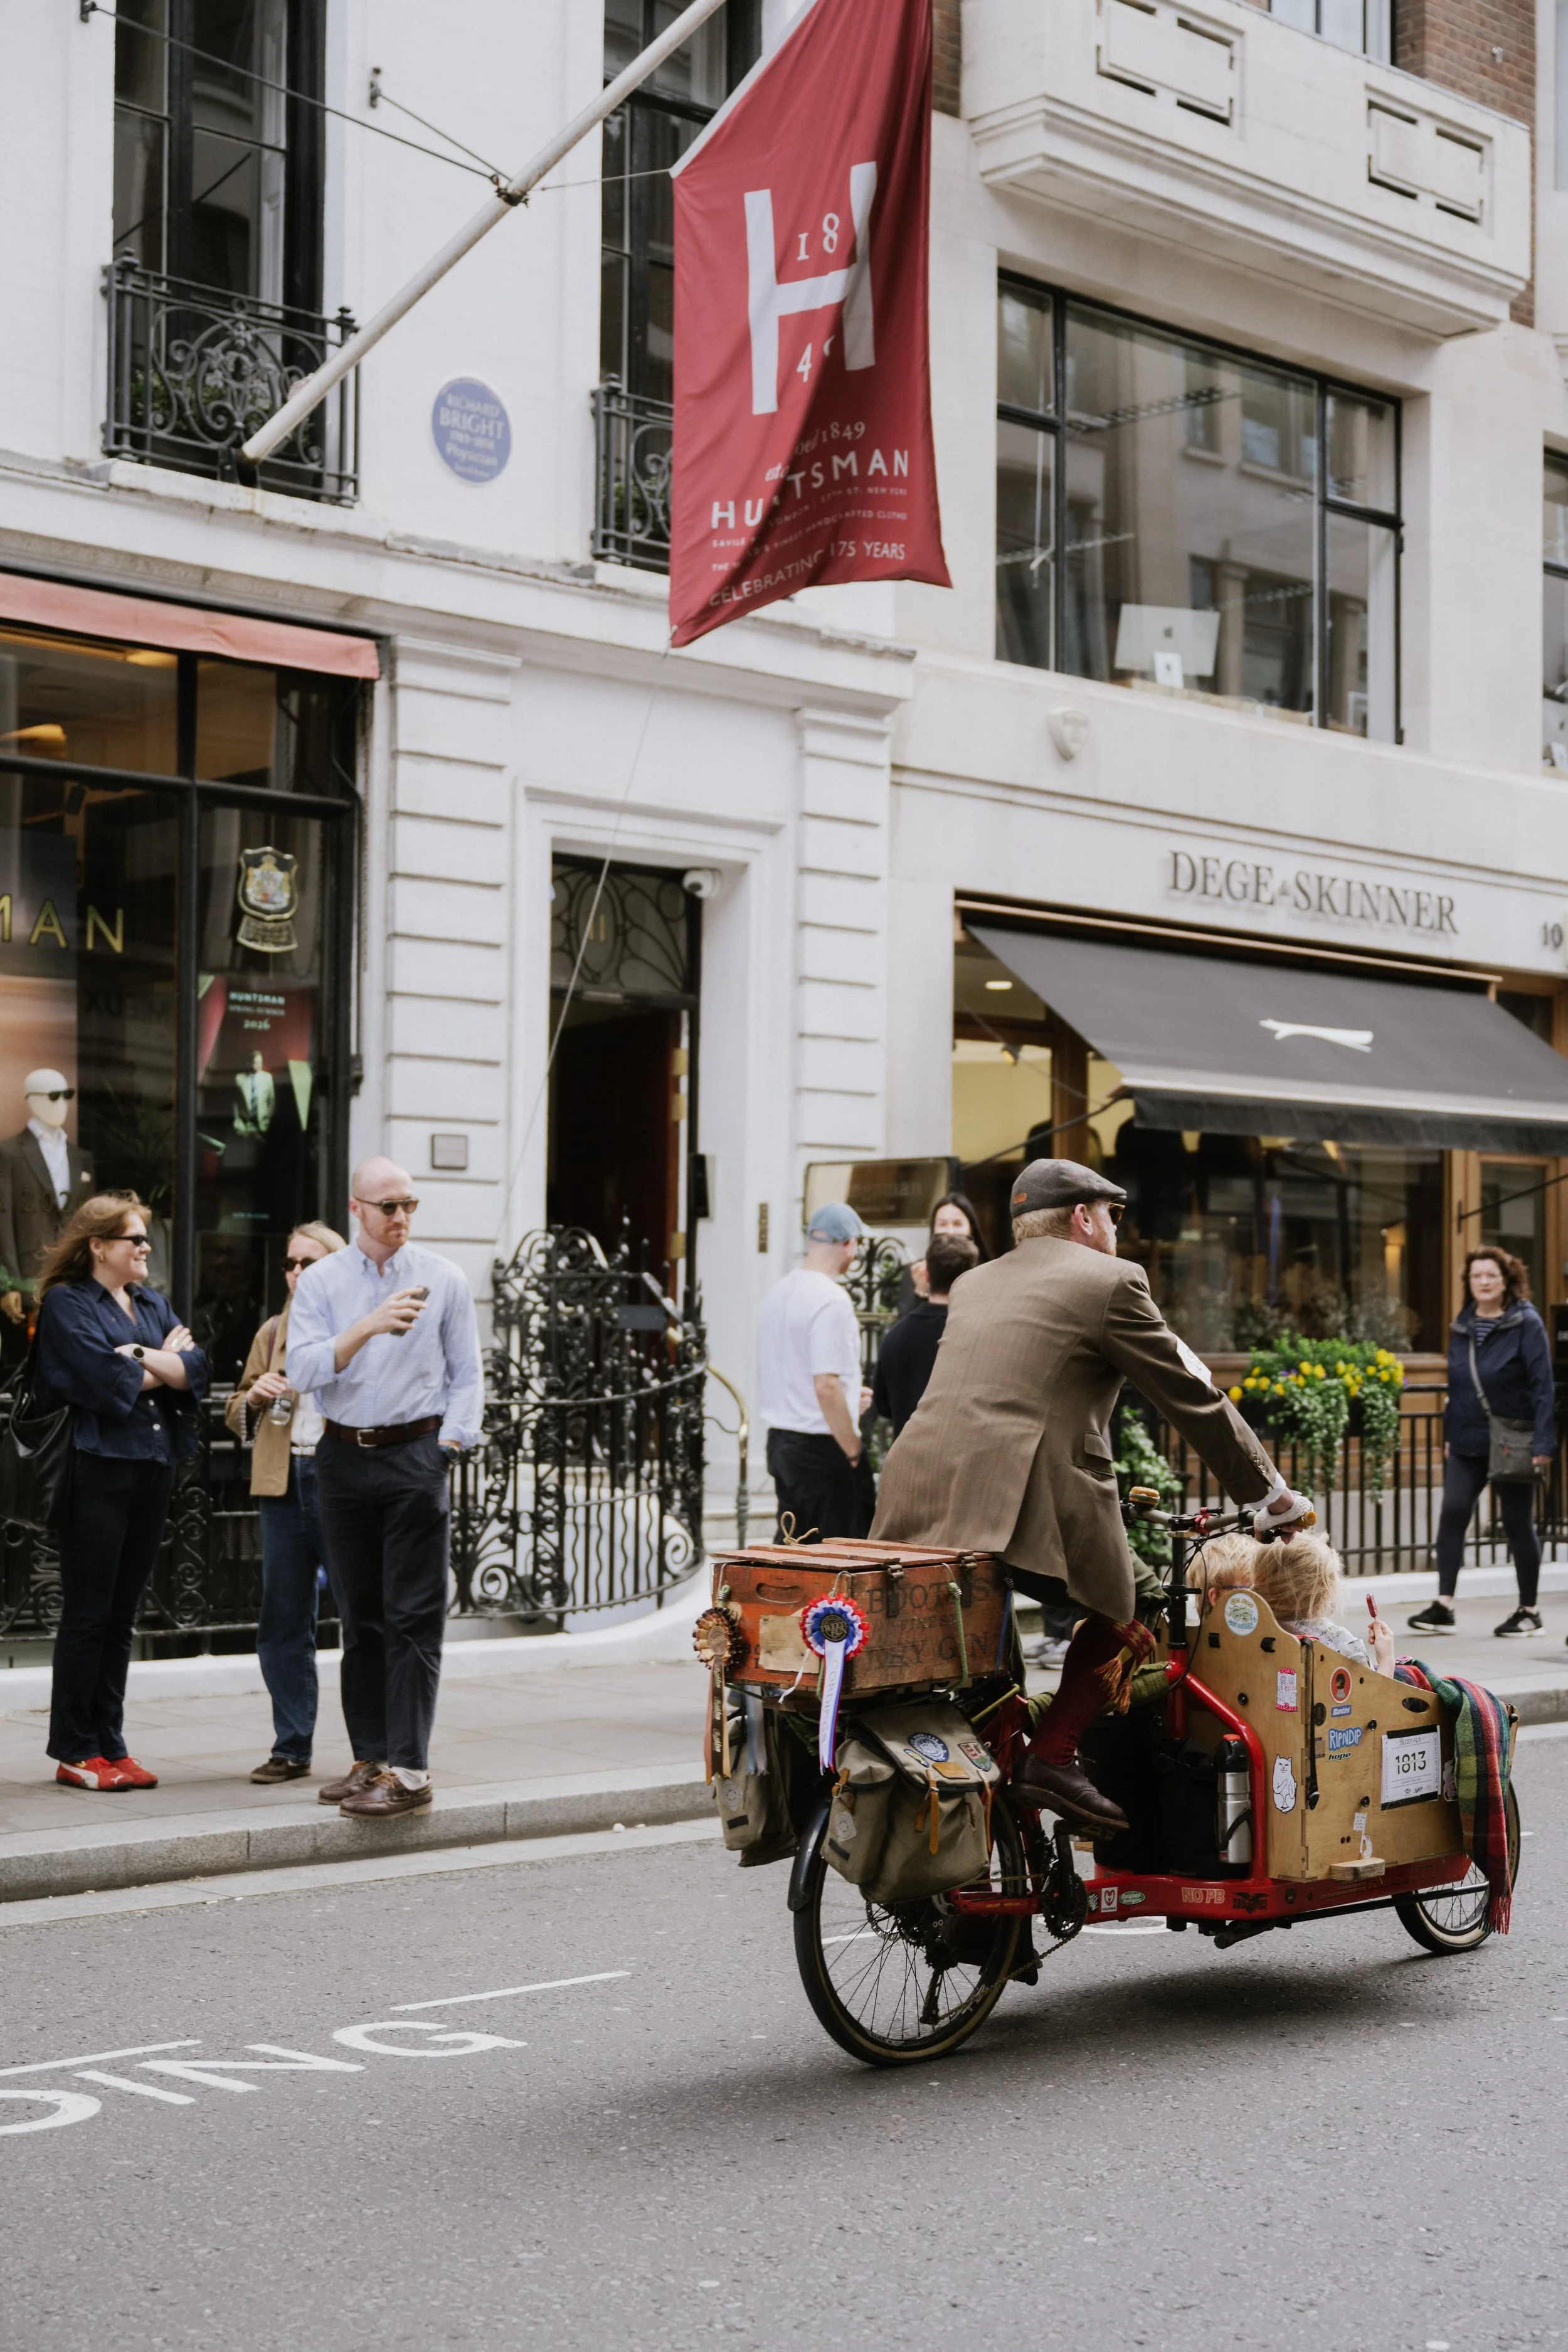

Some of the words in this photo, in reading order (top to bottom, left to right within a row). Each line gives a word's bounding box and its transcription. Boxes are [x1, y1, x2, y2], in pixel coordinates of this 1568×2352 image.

[439, 406, 504, 440] BRIGHT
[820, 421, 866, 443] 1849
[711, 448, 909, 529] HUTSMAN
[830, 541, 856, 558] 175
[862, 541, 906, 561] YEARS
[1169, 850, 1275, 906] DEGE
[1293, 871, 1459, 935] SKINNER
[229, 991, 285, 1005] HUNTSMAN
[866, 1579, 990, 1614] BOTS
[1329, 1728, 1362, 1750] RIPNDIP
[1396, 1751, 1426, 1775] 1813
[1182, 1887, 1204, 1903] NO
[1205, 1888, 1226, 1904] PB
